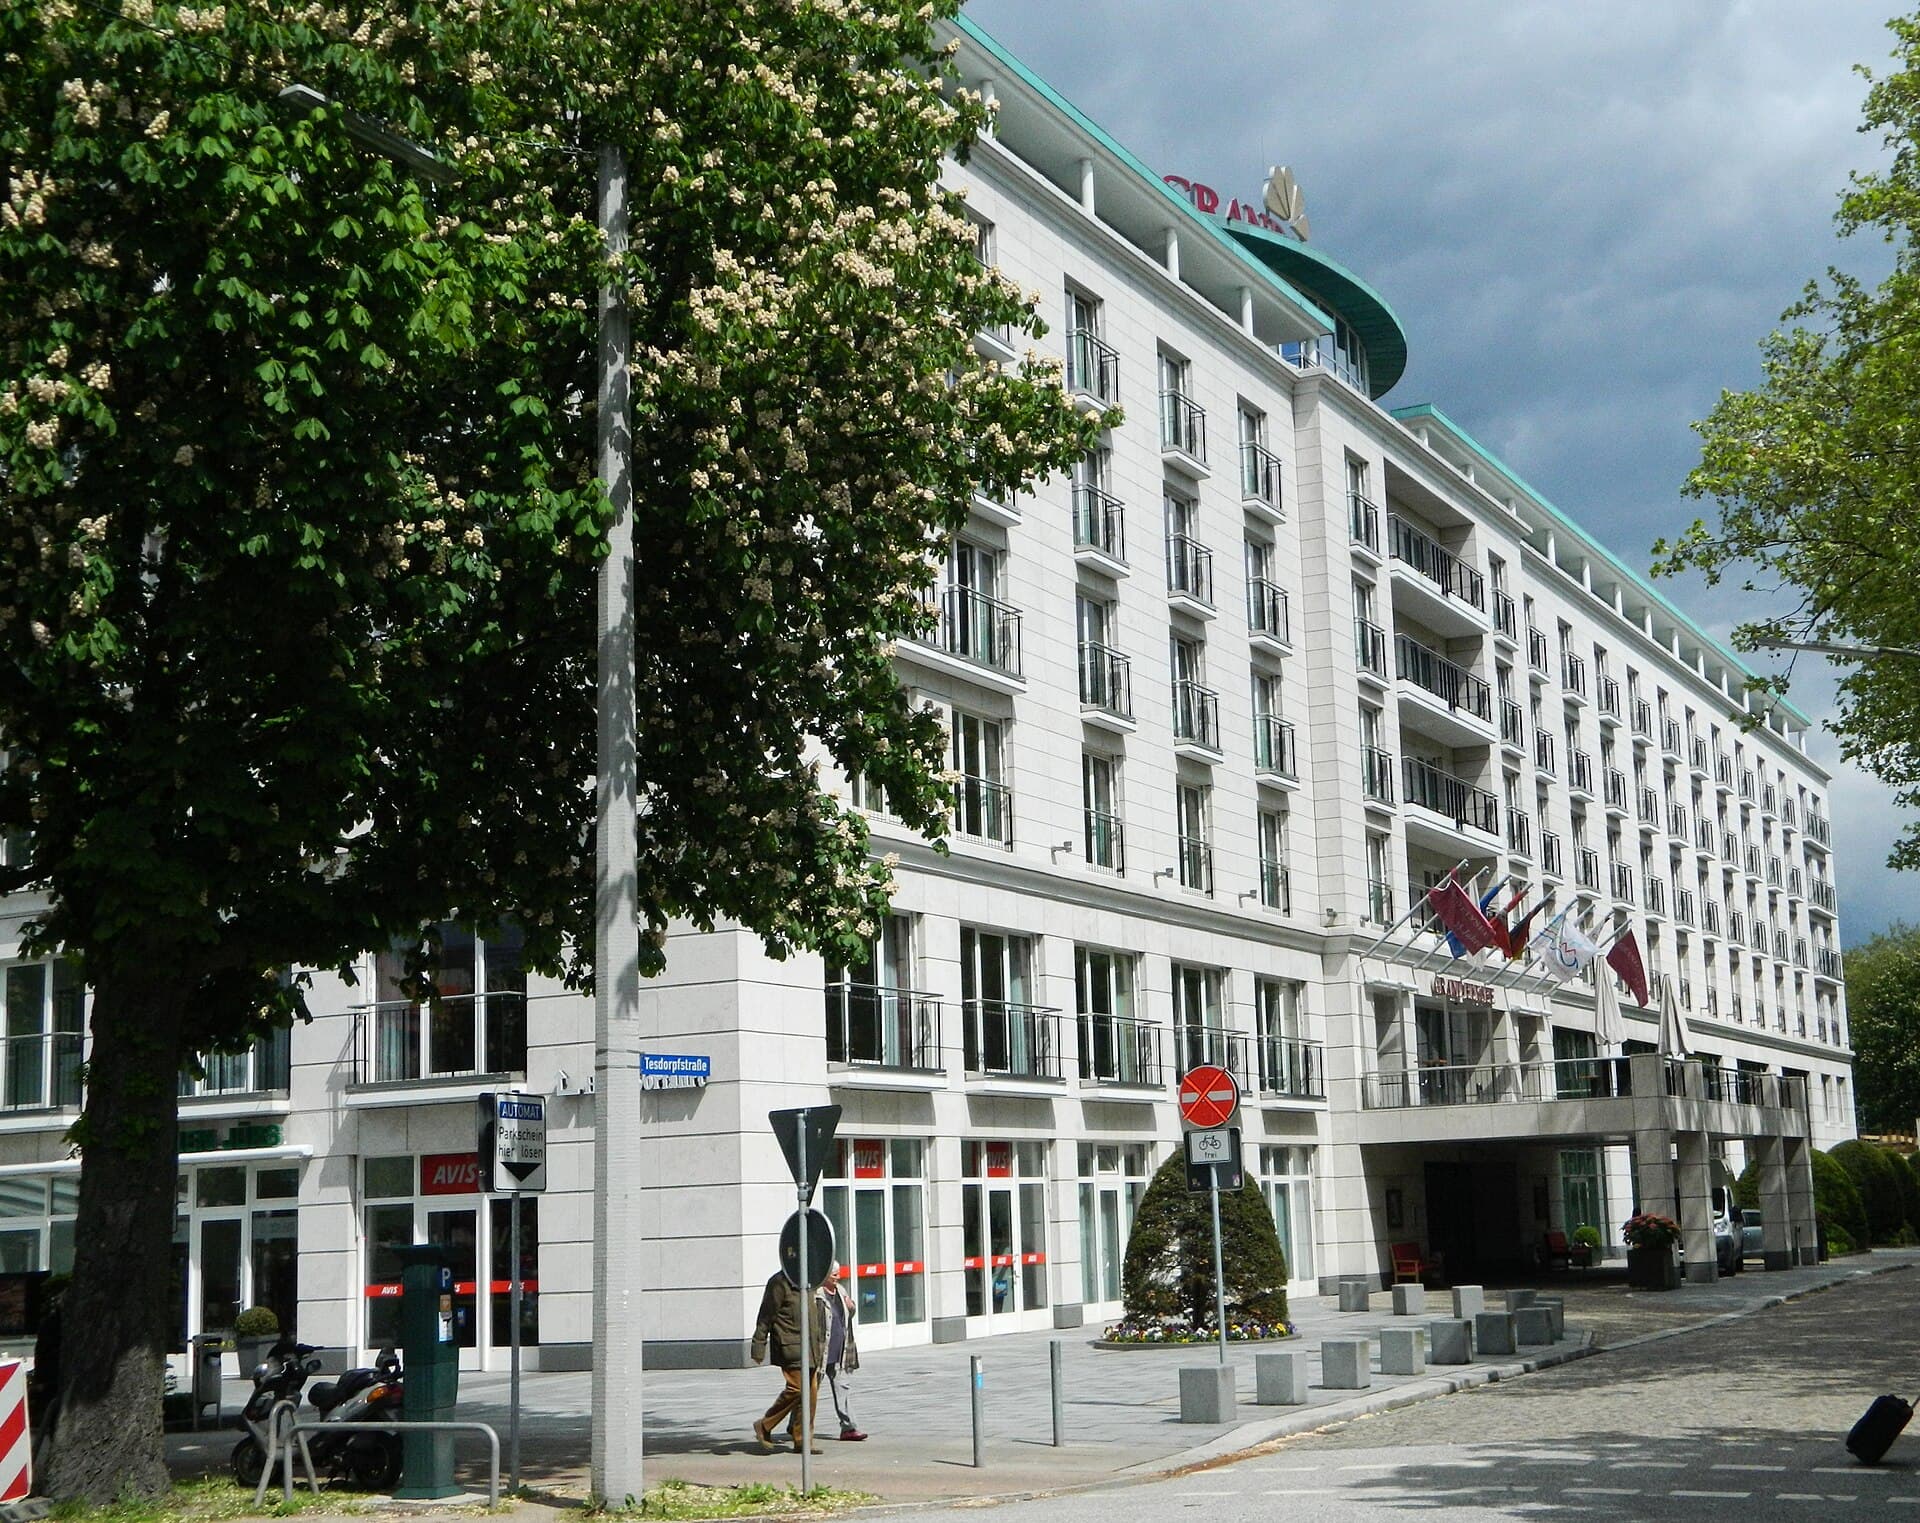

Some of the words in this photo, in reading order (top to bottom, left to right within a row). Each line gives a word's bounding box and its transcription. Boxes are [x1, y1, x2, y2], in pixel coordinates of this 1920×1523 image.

[644, 1056, 707, 1073] Tesdorpfstraße
[501, 1103, 540, 1119] AUTOMAT
[498, 1126, 543, 1142] Parkschein
[498, 1146, 515, 1158] hier
[521, 1146, 543, 1158] lösen
[432, 1163, 478, 1185] AVIS
[441, 1267, 451, 1288] P
[381, 1285, 398, 1295] AVIS
